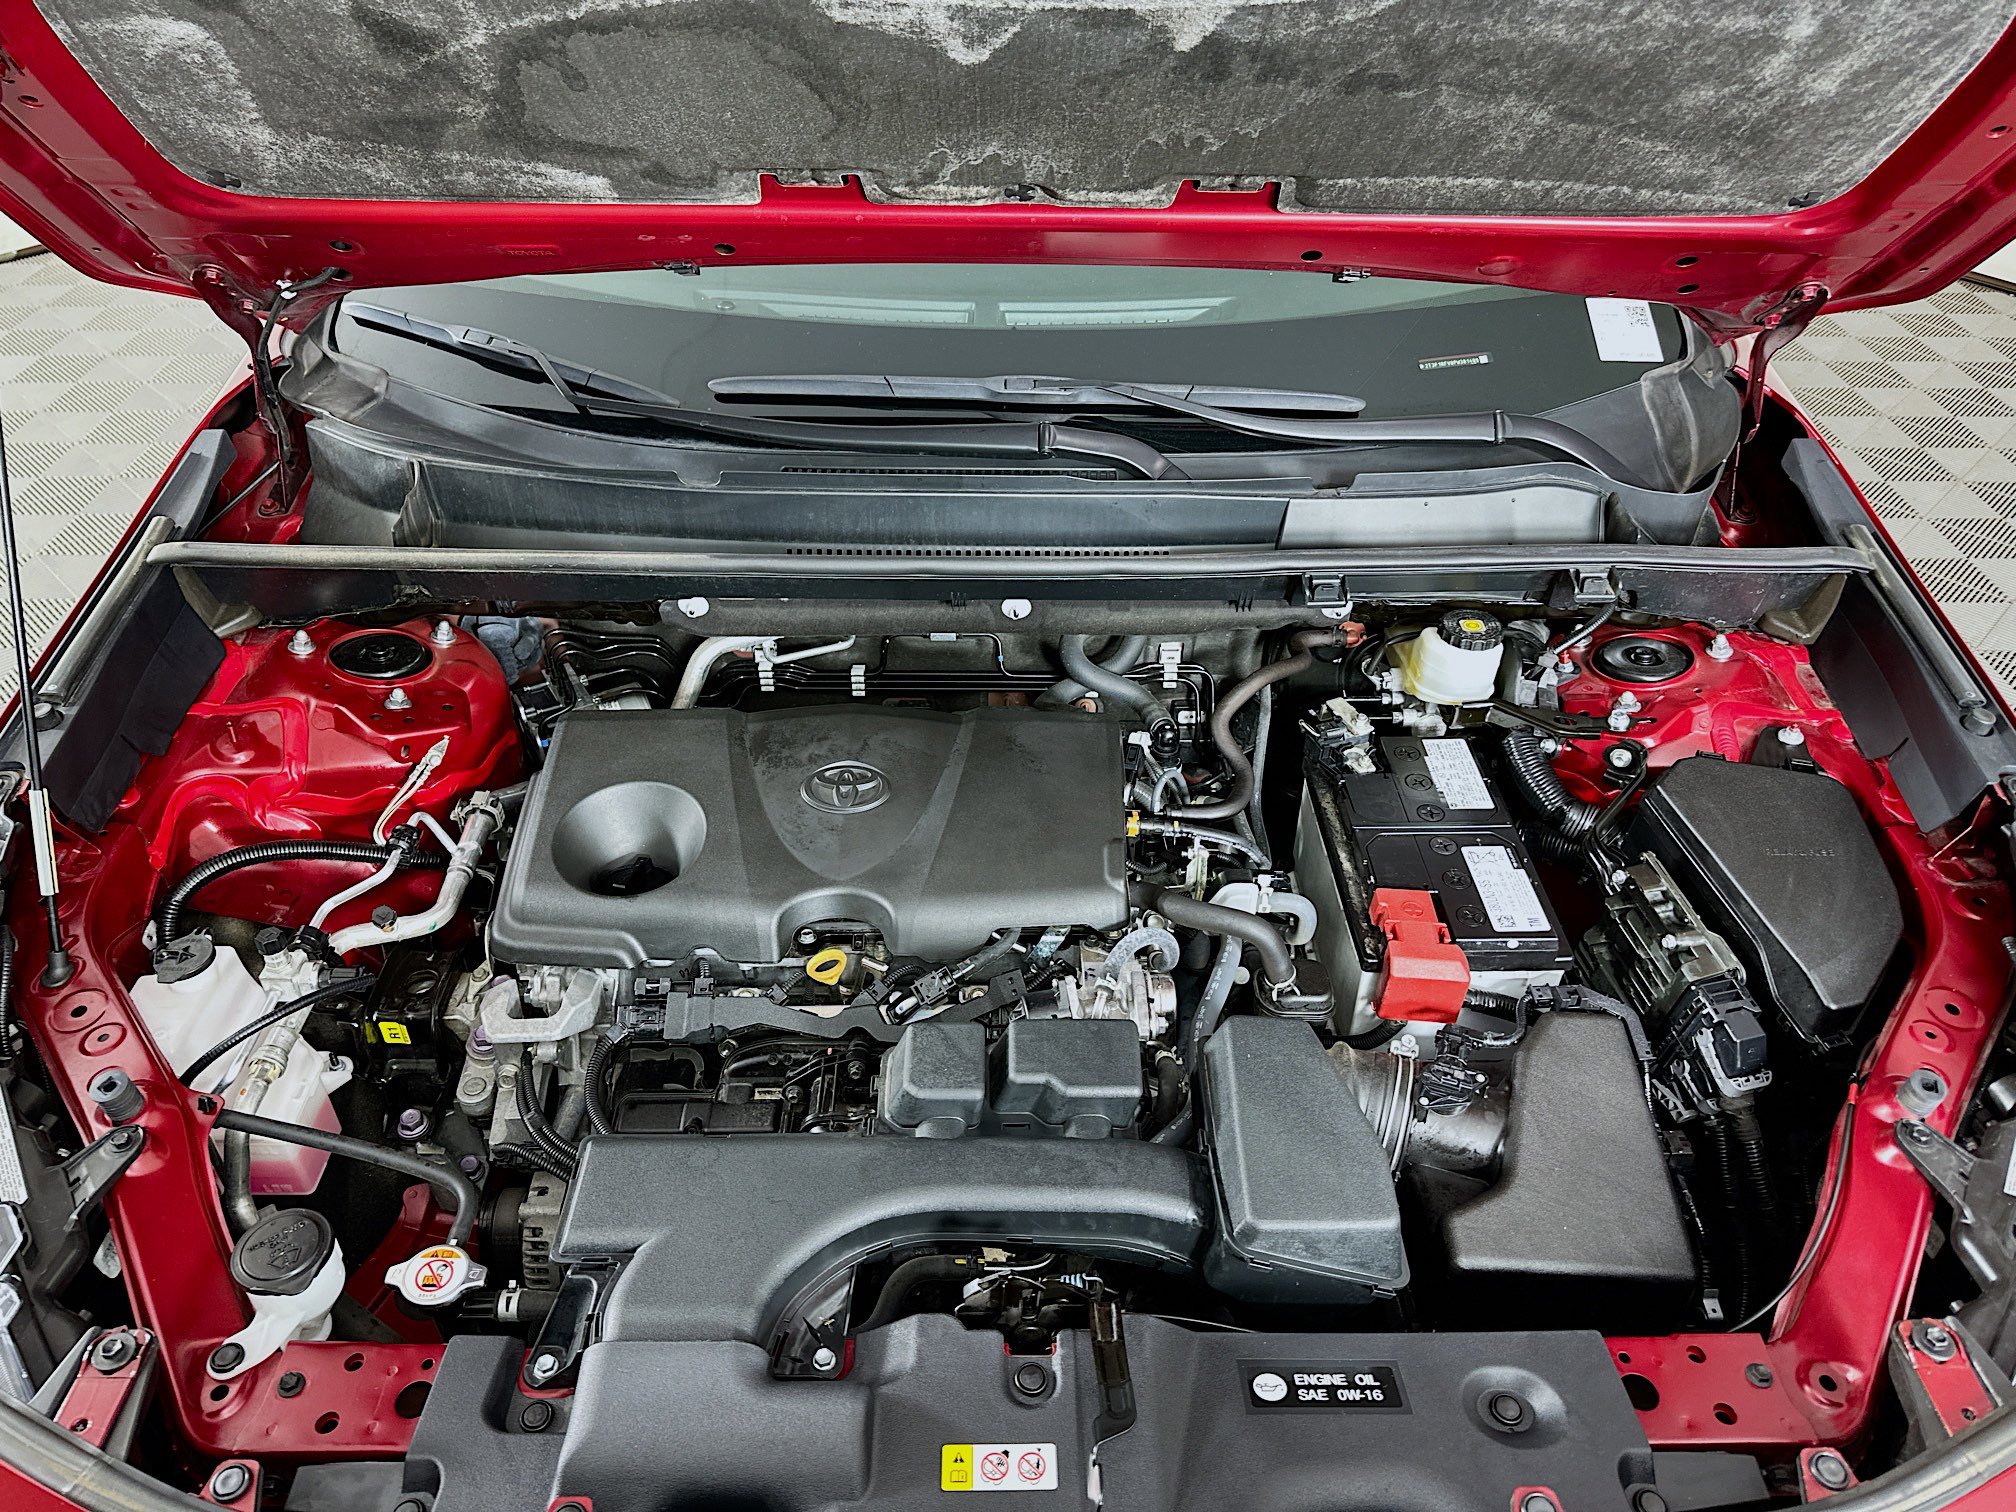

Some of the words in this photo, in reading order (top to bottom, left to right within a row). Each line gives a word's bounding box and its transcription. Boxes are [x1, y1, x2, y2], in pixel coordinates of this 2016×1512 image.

[1293, 1373, 1348, 1386] ENGINE
[1354, 1373, 1381, 1386] OIL
[1297, 1389, 1329, 1401] SAE
[1337, 1389, 1385, 1402] 0W-16
